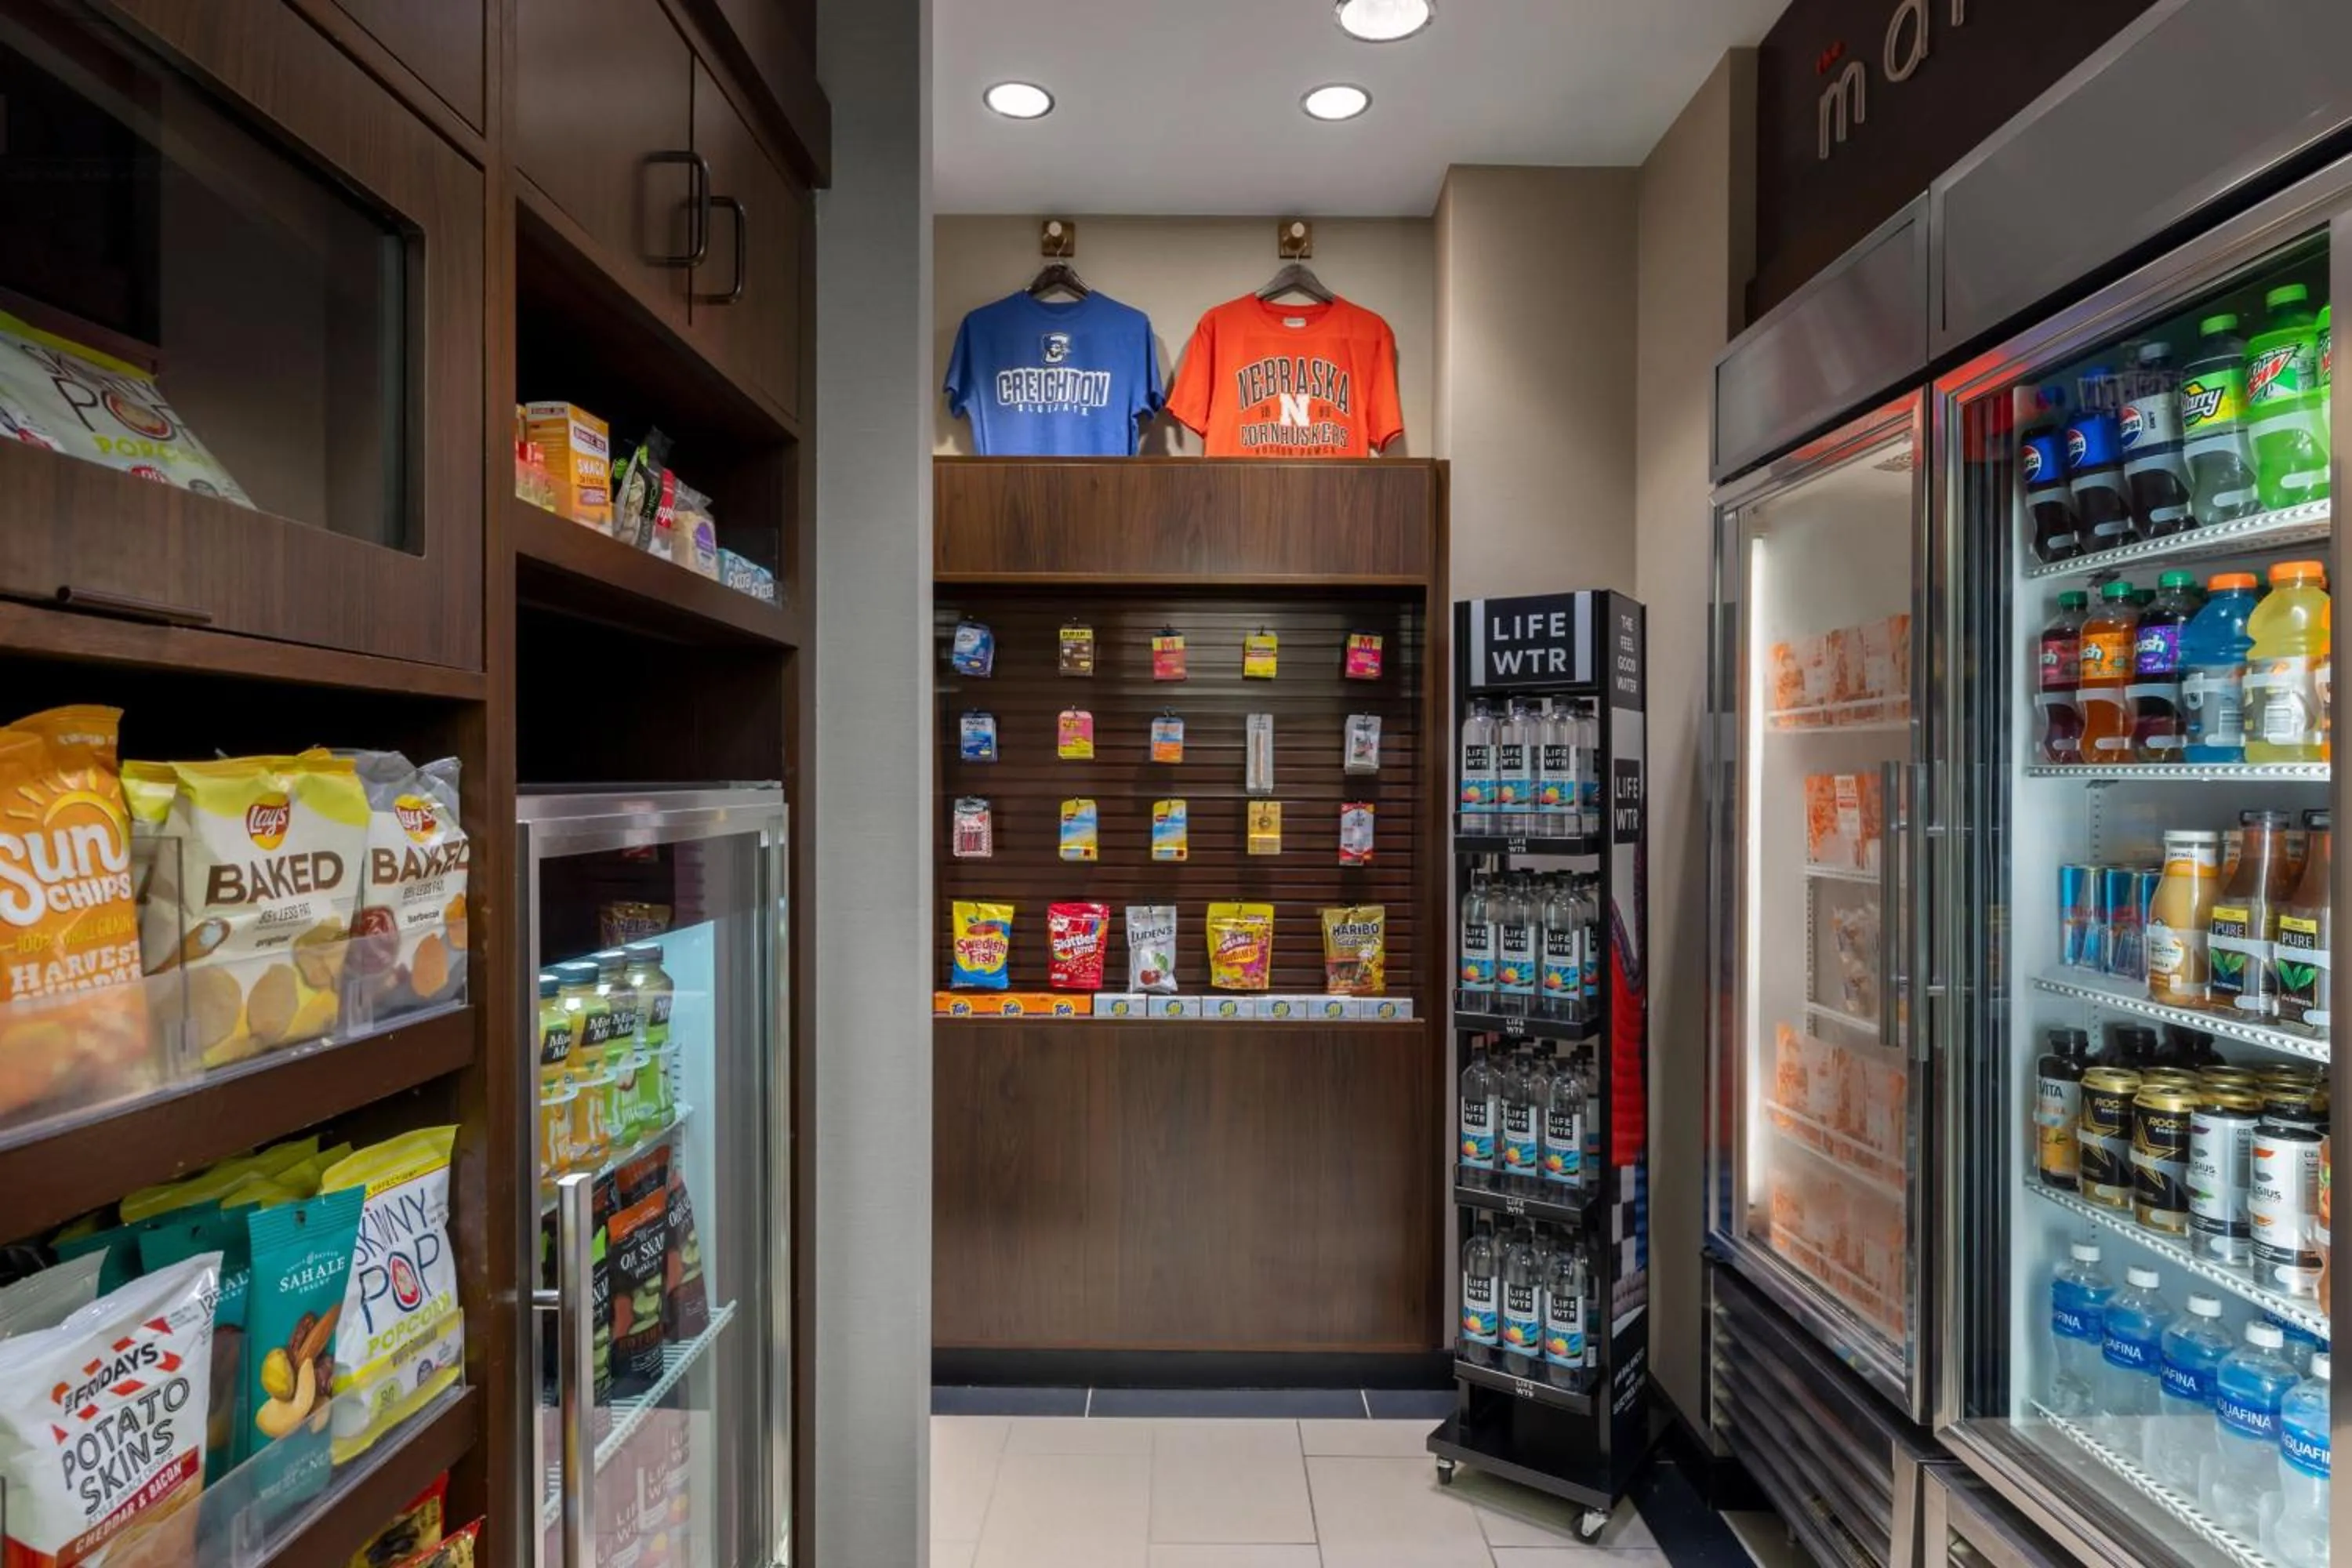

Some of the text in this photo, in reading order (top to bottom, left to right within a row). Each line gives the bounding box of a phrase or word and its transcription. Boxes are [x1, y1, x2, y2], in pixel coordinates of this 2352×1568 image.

[996, 367, 1110, 407] CREIGHTON
[1236, 358, 1350, 416] NEBRASKA
[1278, 392, 1310, 426] N
[1241, 420, 1348, 448] CORNHUSKERS
[1493, 612, 1566, 641] LIFE
[2136, 633, 2165, 653] ush
[1493, 648, 1566, 675] WTR
[1617, 655, 1636, 673] GOOD
[1616, 676, 1638, 694] WATER
[1466, 748, 1488, 757] LIFE
[1501, 748, 1521, 757] LIFE
[1545, 748, 1567, 757] LIFE
[1466, 757, 1487, 767] WTR
[1501, 757, 1521, 766] WTR
[1545, 757, 1567, 767] WTR
[1616, 775, 1639, 800] LIFE
[249, 804, 288, 838] Lay's
[1616, 808, 1639, 830] WTR
[0, 823, 130, 926] Sun
[205, 851, 344, 906] BAKED
[46, 872, 132, 913] CHIPS
[1131, 925, 1174, 943] LUDEN'S
[1333, 923, 1380, 936] HARIBO
[1466, 928, 1486, 937] LIFE
[1504, 930, 1527, 938] LIFE
[2215, 921, 2244, 936] PURE
[1465, 937, 1486, 947] WTR
[1504, 938, 1527, 949] WTR
[1548, 933, 1571, 942] LIFE
[2282, 931, 2313, 948] PURE
[956, 938, 1007, 956] Swedish
[1548, 943, 1572, 953] WTR
[967, 949, 998, 965] Fish
[10, 938, 143, 994] HARVEST
[952, 1004, 970, 1015] Tide
[1003, 1004, 1022, 1015] Tide
[2039, 1079, 2063, 1098] VITA
[1465, 1104, 1486, 1113] LIFE
[1508, 1109, 1528, 1120] LIFE
[1465, 1113, 1486, 1123] WTR
[1508, 1120, 1529, 1129] WTR
[1548, 1116, 1571, 1126] LIFE
[1549, 1126, 1572, 1136] WTR
[2194, 1161, 2216, 1174] SIUS
[2256, 1186, 2281, 1200] SIUS
[278, 1256, 346, 1294] SAHALE
[358, 1232, 441, 1334] POP
[1468, 1279, 1490, 1289] LIFE
[1468, 1288, 1490, 1298] WTR
[1509, 1289, 1531, 1299] LIFE
[1509, 1299, 1532, 1309] WTR
[1552, 1298, 1576, 1309] LIFE
[1552, 1309, 1577, 1320] WTR
[2057, 1312, 2083, 1330] FINA
[367, 1290, 452, 1358] POPCORN
[2107, 1338, 2144, 1362] AFINA
[73, 1341, 158, 1410] FRIDAYS
[2217, 1397, 2273, 1431] QUAFINA
[62, 1377, 191, 1490] POTATO
[81, 1418, 175, 1515] SKINS
[74, 1460, 183, 1554] CHEDDAR & BACON
